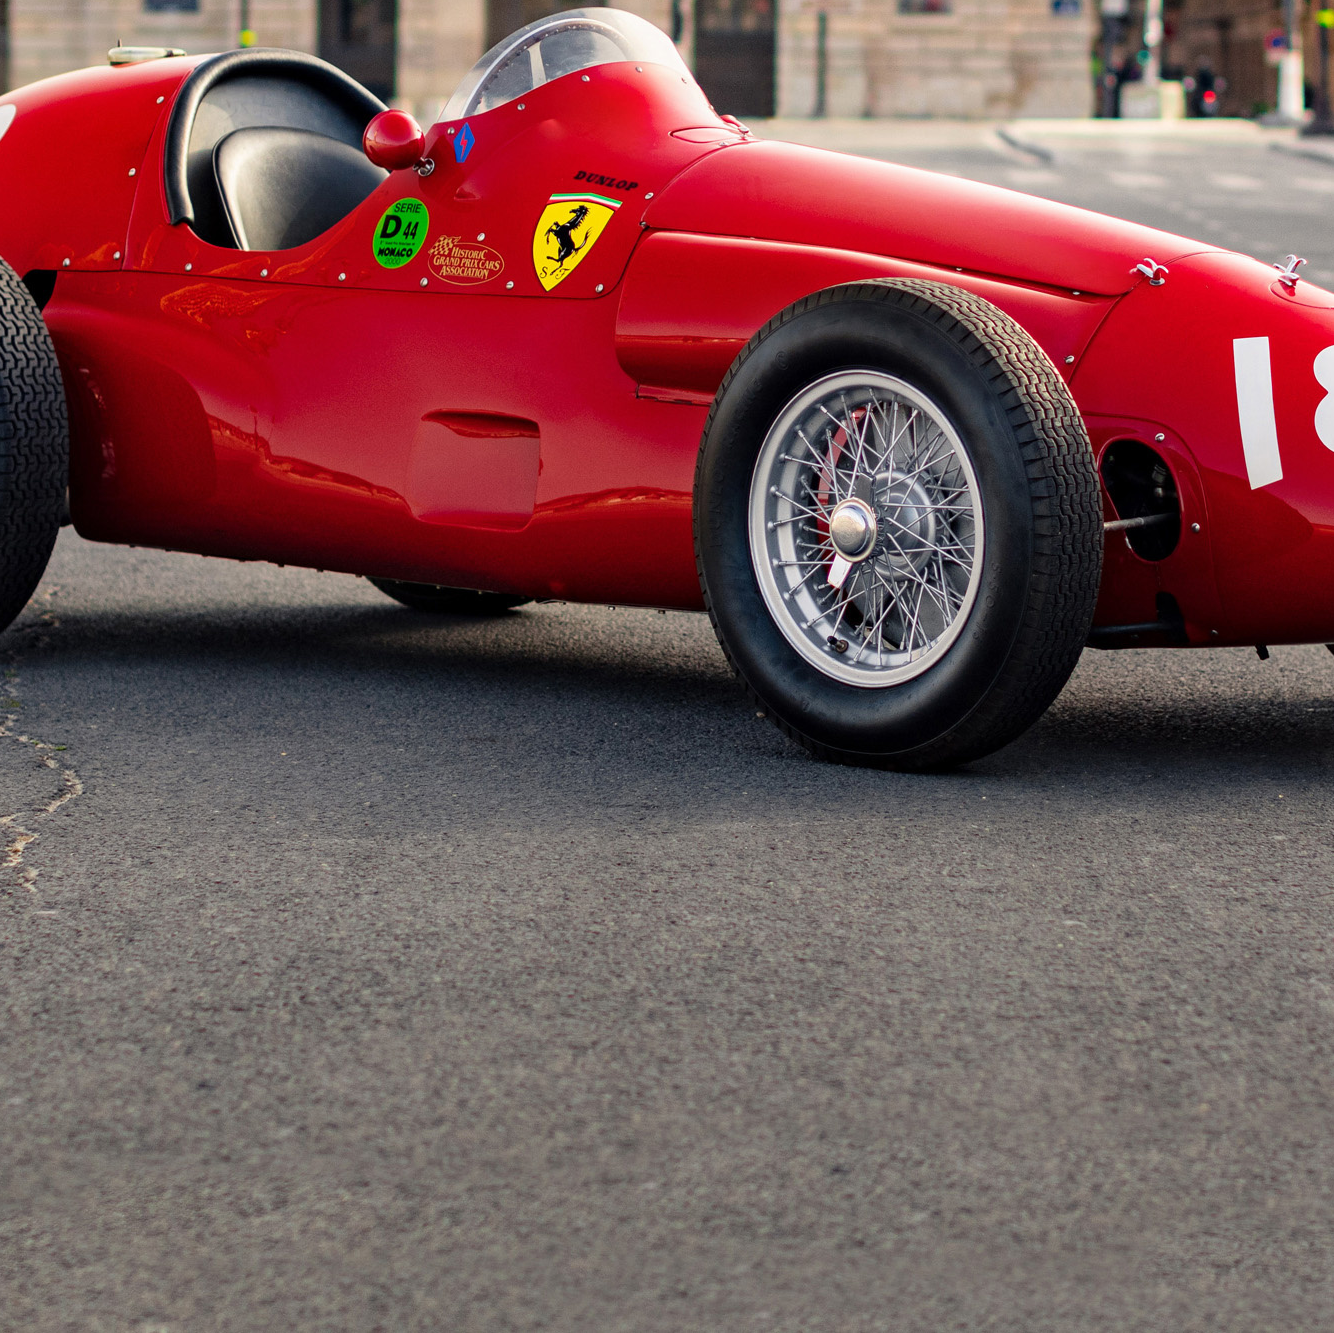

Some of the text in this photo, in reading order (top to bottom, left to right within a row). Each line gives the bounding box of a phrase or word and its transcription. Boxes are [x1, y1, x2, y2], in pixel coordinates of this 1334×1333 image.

[573, 170, 639, 191] DUNLOP
[394, 202, 422, 214] SERIE
[380, 214, 419, 240] D 44
[377, 246, 413, 258] MONACO
[451, 247, 488, 260] HISTORIC
[433, 255, 500, 271] GRAND PRIX CARS
[439, 266, 489, 280] ASSOCIATION
[539, 266, 571, 280] S F
